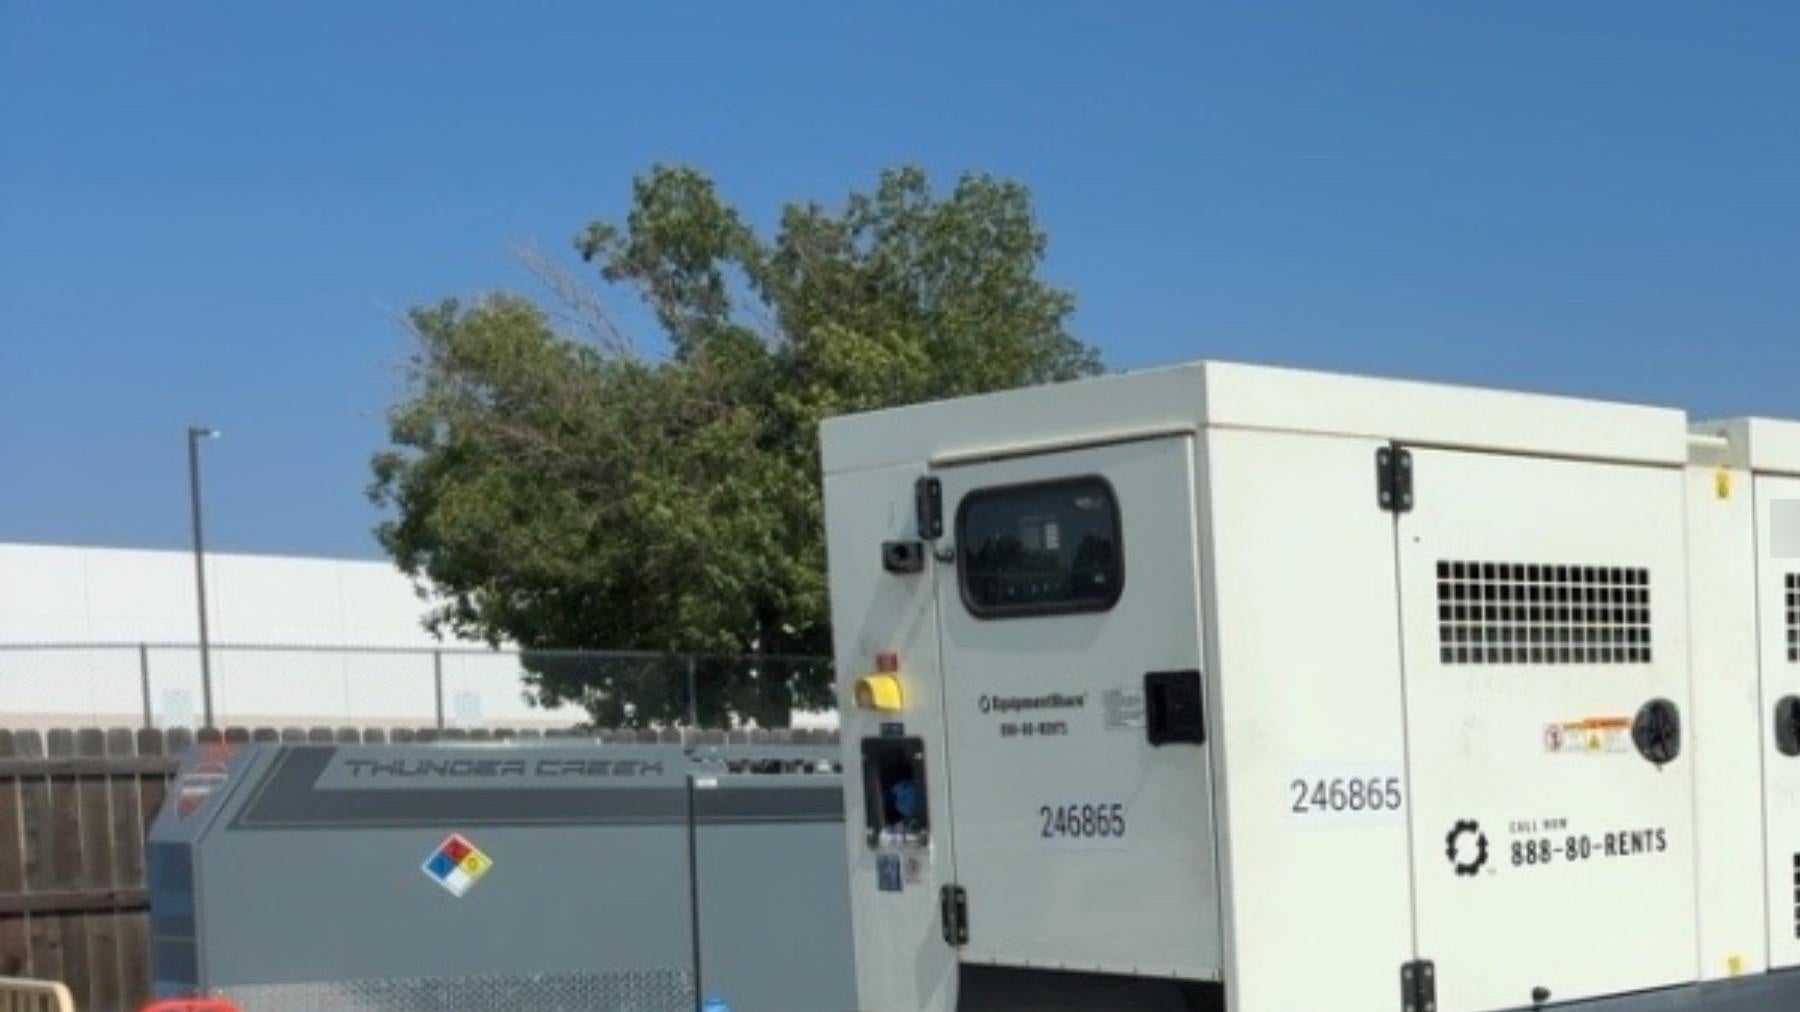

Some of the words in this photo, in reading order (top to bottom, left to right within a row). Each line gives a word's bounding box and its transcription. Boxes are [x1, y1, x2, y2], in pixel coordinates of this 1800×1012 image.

[343, 758, 526, 778] THUNDER
[535, 758, 666, 777] CREEK
[1291, 777, 1402, 814] 246865
[1039, 802, 1126, 839] 246865
[1510, 827, 1667, 867] 888-80-RENTS
